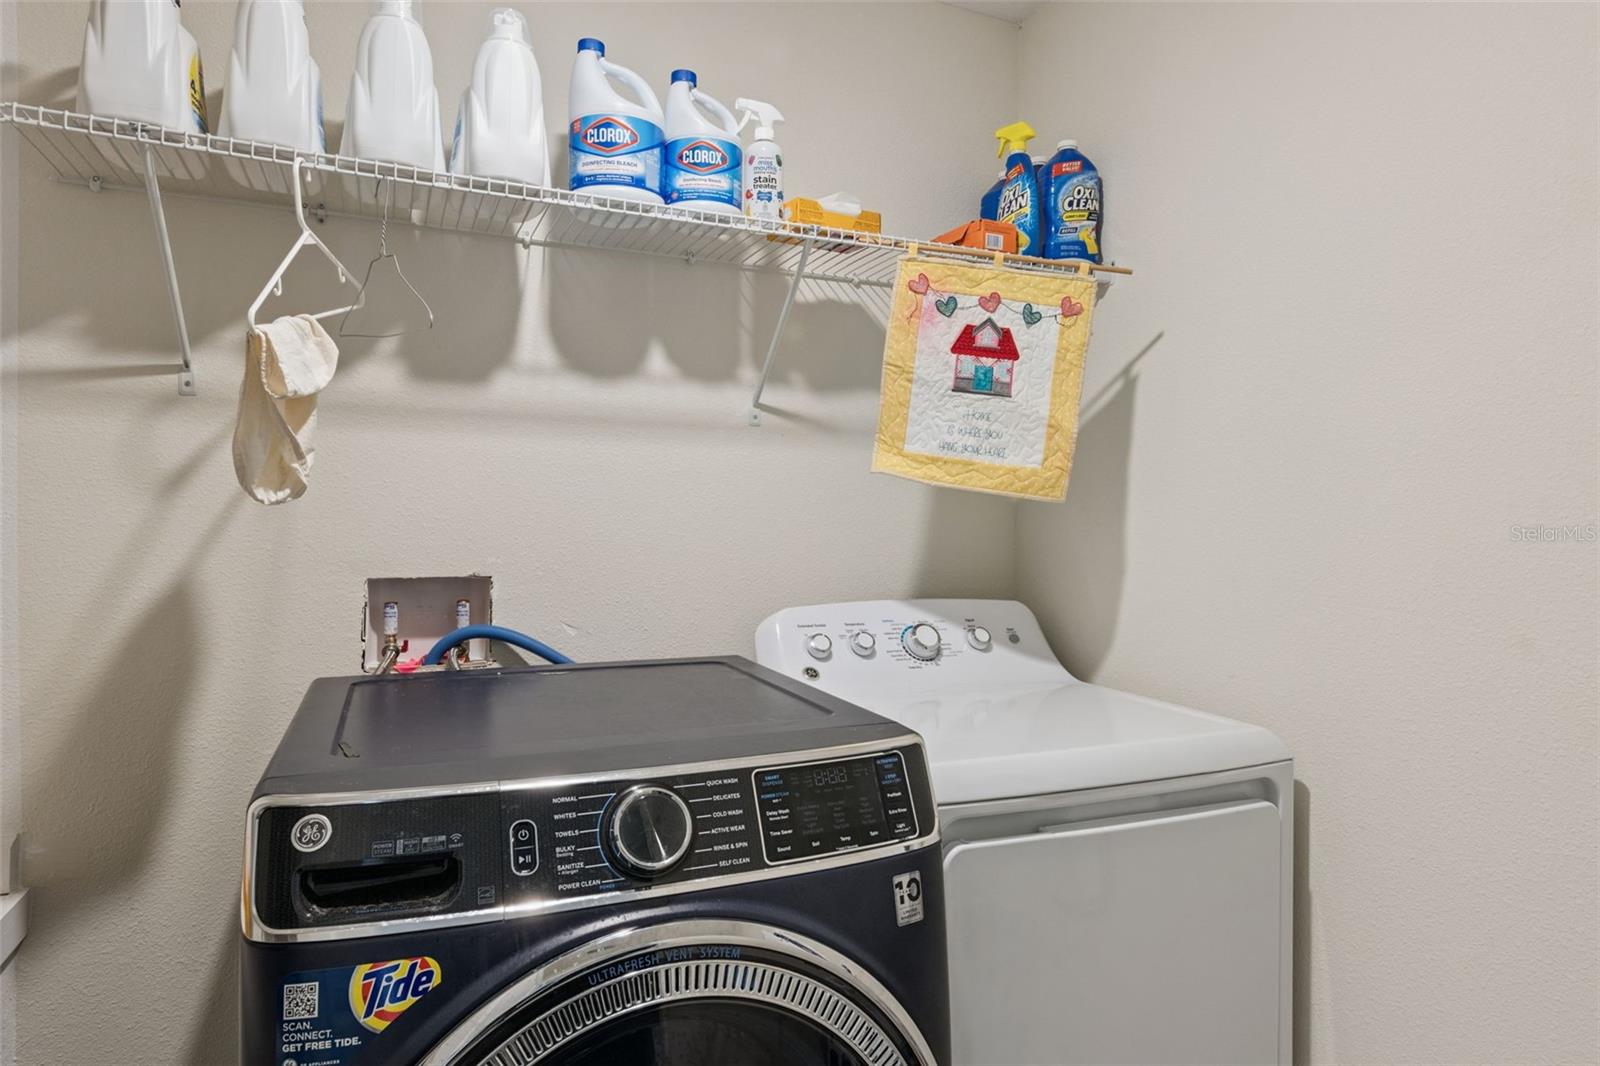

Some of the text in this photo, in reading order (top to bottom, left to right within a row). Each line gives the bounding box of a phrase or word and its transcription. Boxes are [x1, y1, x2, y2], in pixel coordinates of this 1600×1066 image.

[587, 128, 632, 144] CLOROX
[682, 149, 722, 165] CLOROX
[753, 174, 777, 184] stain
[1074, 185, 1095, 199] OXI
[1063, 196, 1099, 212] CLEAN
[706, 779, 723, 787] QUICK
[552, 796, 577, 804] NORMAL
[712, 792, 741, 801] DELICATES
[553, 812, 577, 820] WHITES
[712, 810, 727, 818] COLD
[555, 829, 579, 838] TOWELS
[711, 826, 729, 834] ACTIVE
[555, 845, 576, 853] BULKY
[713, 843, 730, 851] RINSE
[735, 841, 748, 849] SPIN
[732, 857, 750, 865] CLEAN
[557, 862, 585, 871] SANITIZE
[558, 879, 601, 890] POWER CLEAN
[895, 877, 920, 905] 10
[588, 946, 741, 986] ULTRAFRESH VENT SYSTEM
[360, 958, 436, 1021] Tide
[282, 1021, 313, 1032] SCAN.
[282, 1029, 333, 1042] CONNECT.
[282, 1036, 362, 1053] GET FREE TIDE.
